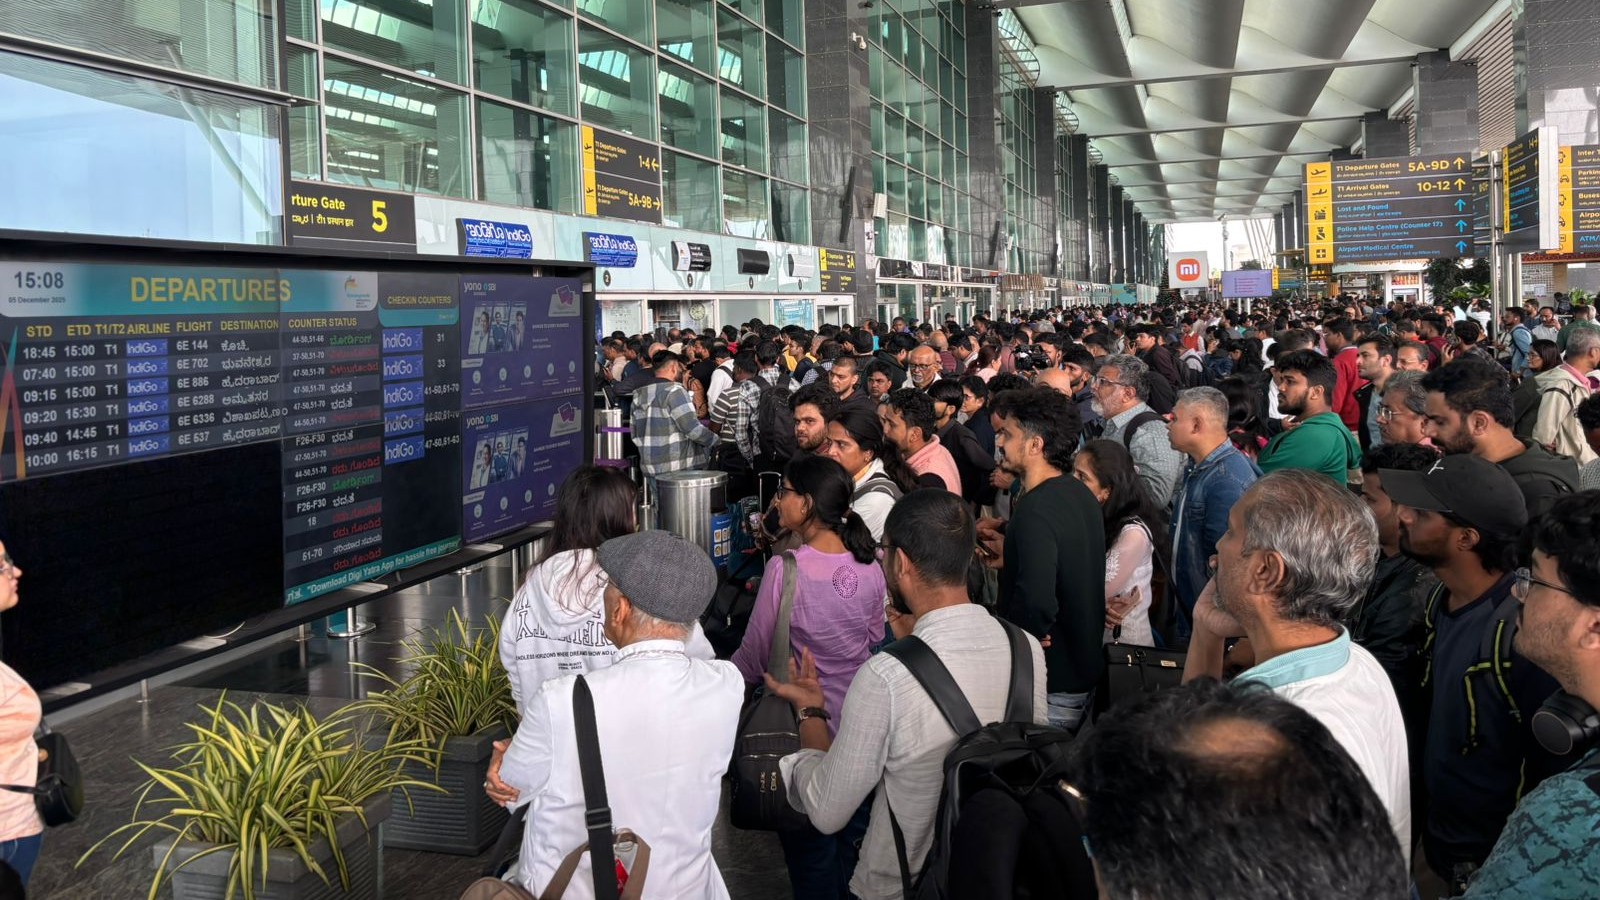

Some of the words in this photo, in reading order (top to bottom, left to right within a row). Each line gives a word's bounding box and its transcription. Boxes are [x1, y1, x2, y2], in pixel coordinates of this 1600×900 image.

[638, 155, 650, 170] 1-4
[1344, 163, 1378, 172] Departure
[1408, 160, 1450, 172] 5A-9D
[1417, 181, 1450, 192] 10-12
[292, 194, 318, 208] rture
[320, 196, 346, 210] Gate
[628, 192, 652, 208] 5A-9B
[372, 200, 388, 232] 5
[505, 228, 531, 242] IndiGo
[1359, 225, 1374, 233] Help
[1400, 222, 1430, 230] (Counter
[618, 239, 637, 250] IndiGo
[1338, 245, 1362, 254] Airport
[14, 272, 64, 289] 15:08
[464, 282, 482, 293] yono
[488, 282, 496, 291] SBI
[131, 276, 292, 302] DEPARTURES
[388, 296, 416, 304] CHECKIN
[418, 295, 452, 304] COUNTERS
[26, 325, 52, 338] STD
[67, 324, 92, 336] ETD
[95, 323, 125, 334] T1/T2
[127, 322, 170, 334] AIRLINE
[176, 321, 212, 332] FLIGHT
[220, 320, 280, 331] DESTINATION
[288, 318, 327, 328] COUNTER
[328, 318, 358, 326] STATUS
[383, 332, 412, 349] IndiGo
[436, 334, 444, 342] 31
[23, 347, 56, 359] 18:45
[64, 344, 96, 357] 15:00
[104, 344, 118, 355] T1
[127, 342, 158, 354] IndiGo
[176, 340, 190, 351] 6E
[192, 340, 208, 350] 144
[23, 368, 56, 381] 07:40
[64, 365, 96, 378] 15:00
[105, 364, 118, 376] T1
[128, 362, 158, 374] IndiGo
[176, 360, 190, 370] 6E
[192, 358, 208, 369] 702
[384, 360, 412, 376] IndiGo
[437, 360, 446, 368] 33
[24, 389, 57, 402] 09:15
[65, 386, 96, 399] 15:00
[105, 384, 118, 396] T1
[128, 381, 158, 394] IndiGo
[177, 378, 190, 389] 6E
[384, 387, 413, 405] IndiGo
[24, 410, 58, 424] 09:20
[66, 406, 96, 420] 15:30
[106, 404, 119, 416] T1
[128, 400, 158, 414] IndiGo
[177, 397, 190, 408] 6E
[24, 431, 58, 446] 09:40
[66, 426, 97, 441] 14:45
[106, 424, 120, 436] T1
[128, 420, 159, 434] IndiGo
[178, 416, 191, 427] 6E
[193, 412, 216, 424] 6336
[384, 415, 414, 432] IndiGo
[466, 415, 484, 428] yono
[490, 414, 498, 422] SBI
[296, 433, 326, 446] F26-F30
[26, 452, 58, 468] 10:00
[66, 446, 98, 462] 16:15
[107, 444, 120, 456] T1
[129, 440, 159, 454] IndiGo
[178, 434, 192, 446] 6E
[385, 442, 414, 460] IndiGo
[296, 482, 326, 496] F26-F30
[296, 498, 327, 513] F26-F30
[363, 564, 380, 576] Yatra
[381, 558, 394, 571] App
[395, 556, 404, 566] for
